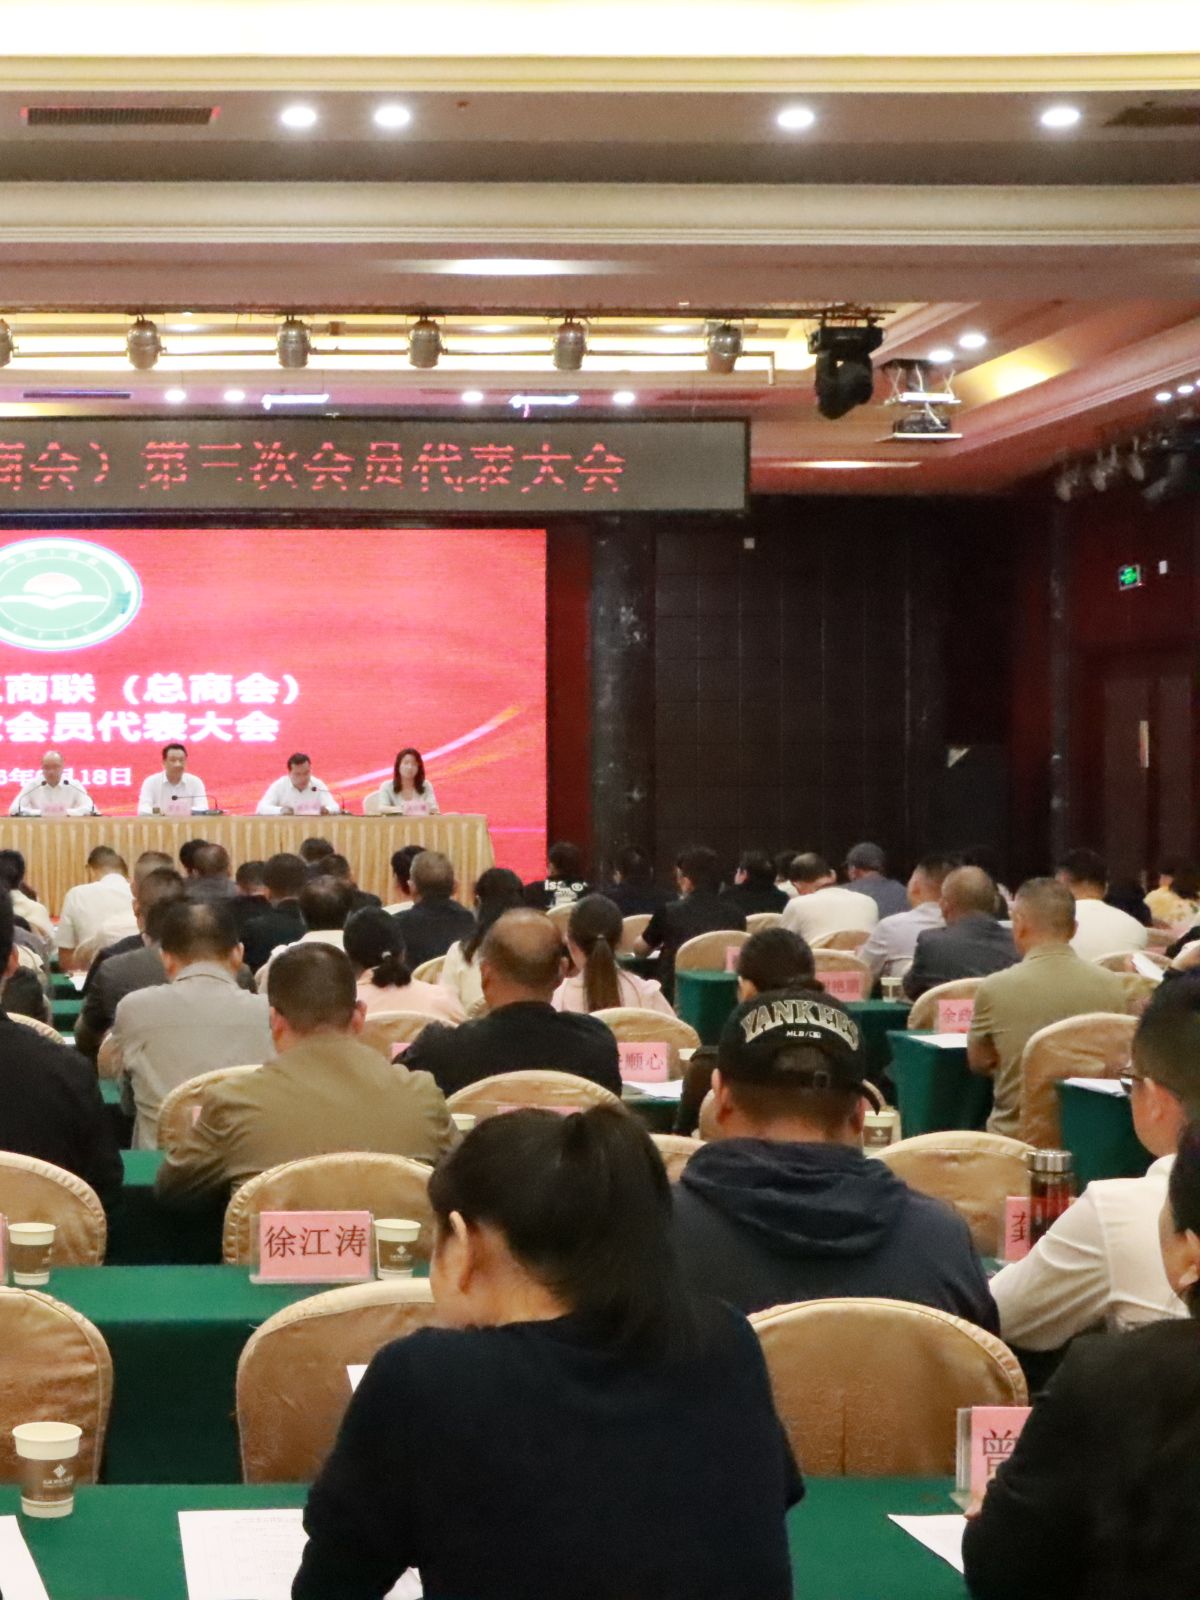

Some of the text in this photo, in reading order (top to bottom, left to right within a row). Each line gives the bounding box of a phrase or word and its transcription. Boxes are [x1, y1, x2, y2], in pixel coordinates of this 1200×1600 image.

[740, 999, 859, 1051] YANKEES
[618, 1051, 664, 1071] 顺心
[264, 1224, 367, 1258] 徐江涛
